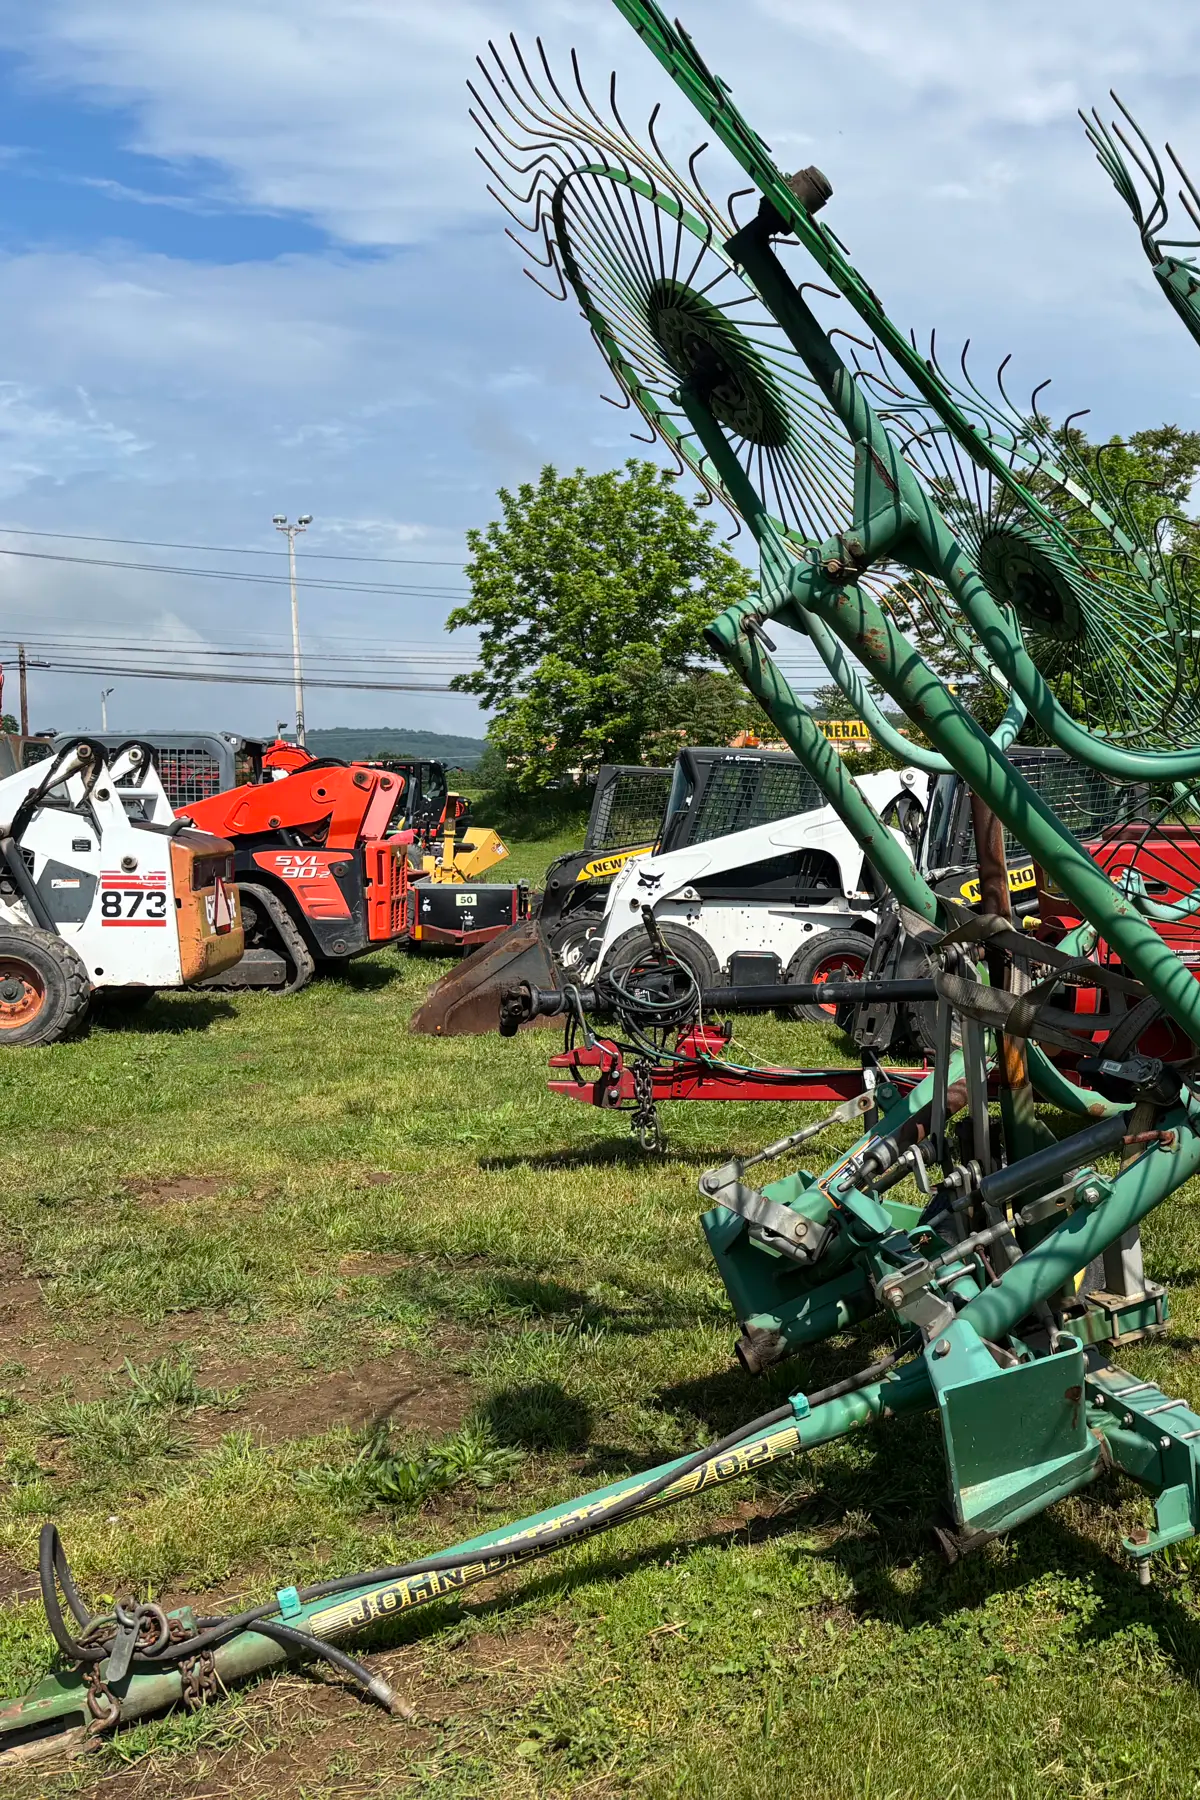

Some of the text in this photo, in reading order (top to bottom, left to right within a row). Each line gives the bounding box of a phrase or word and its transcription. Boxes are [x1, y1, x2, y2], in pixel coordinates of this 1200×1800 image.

[275, 855, 325, 866] SVL
[592, 858, 622, 873] NEW
[281, 866, 331, 879] 90-2
[101, 891, 167, 918] 873
[460, 896, 473, 904] 50
[350, 1567, 465, 1626] JOHN
[692, 1441, 774, 1491] 702
